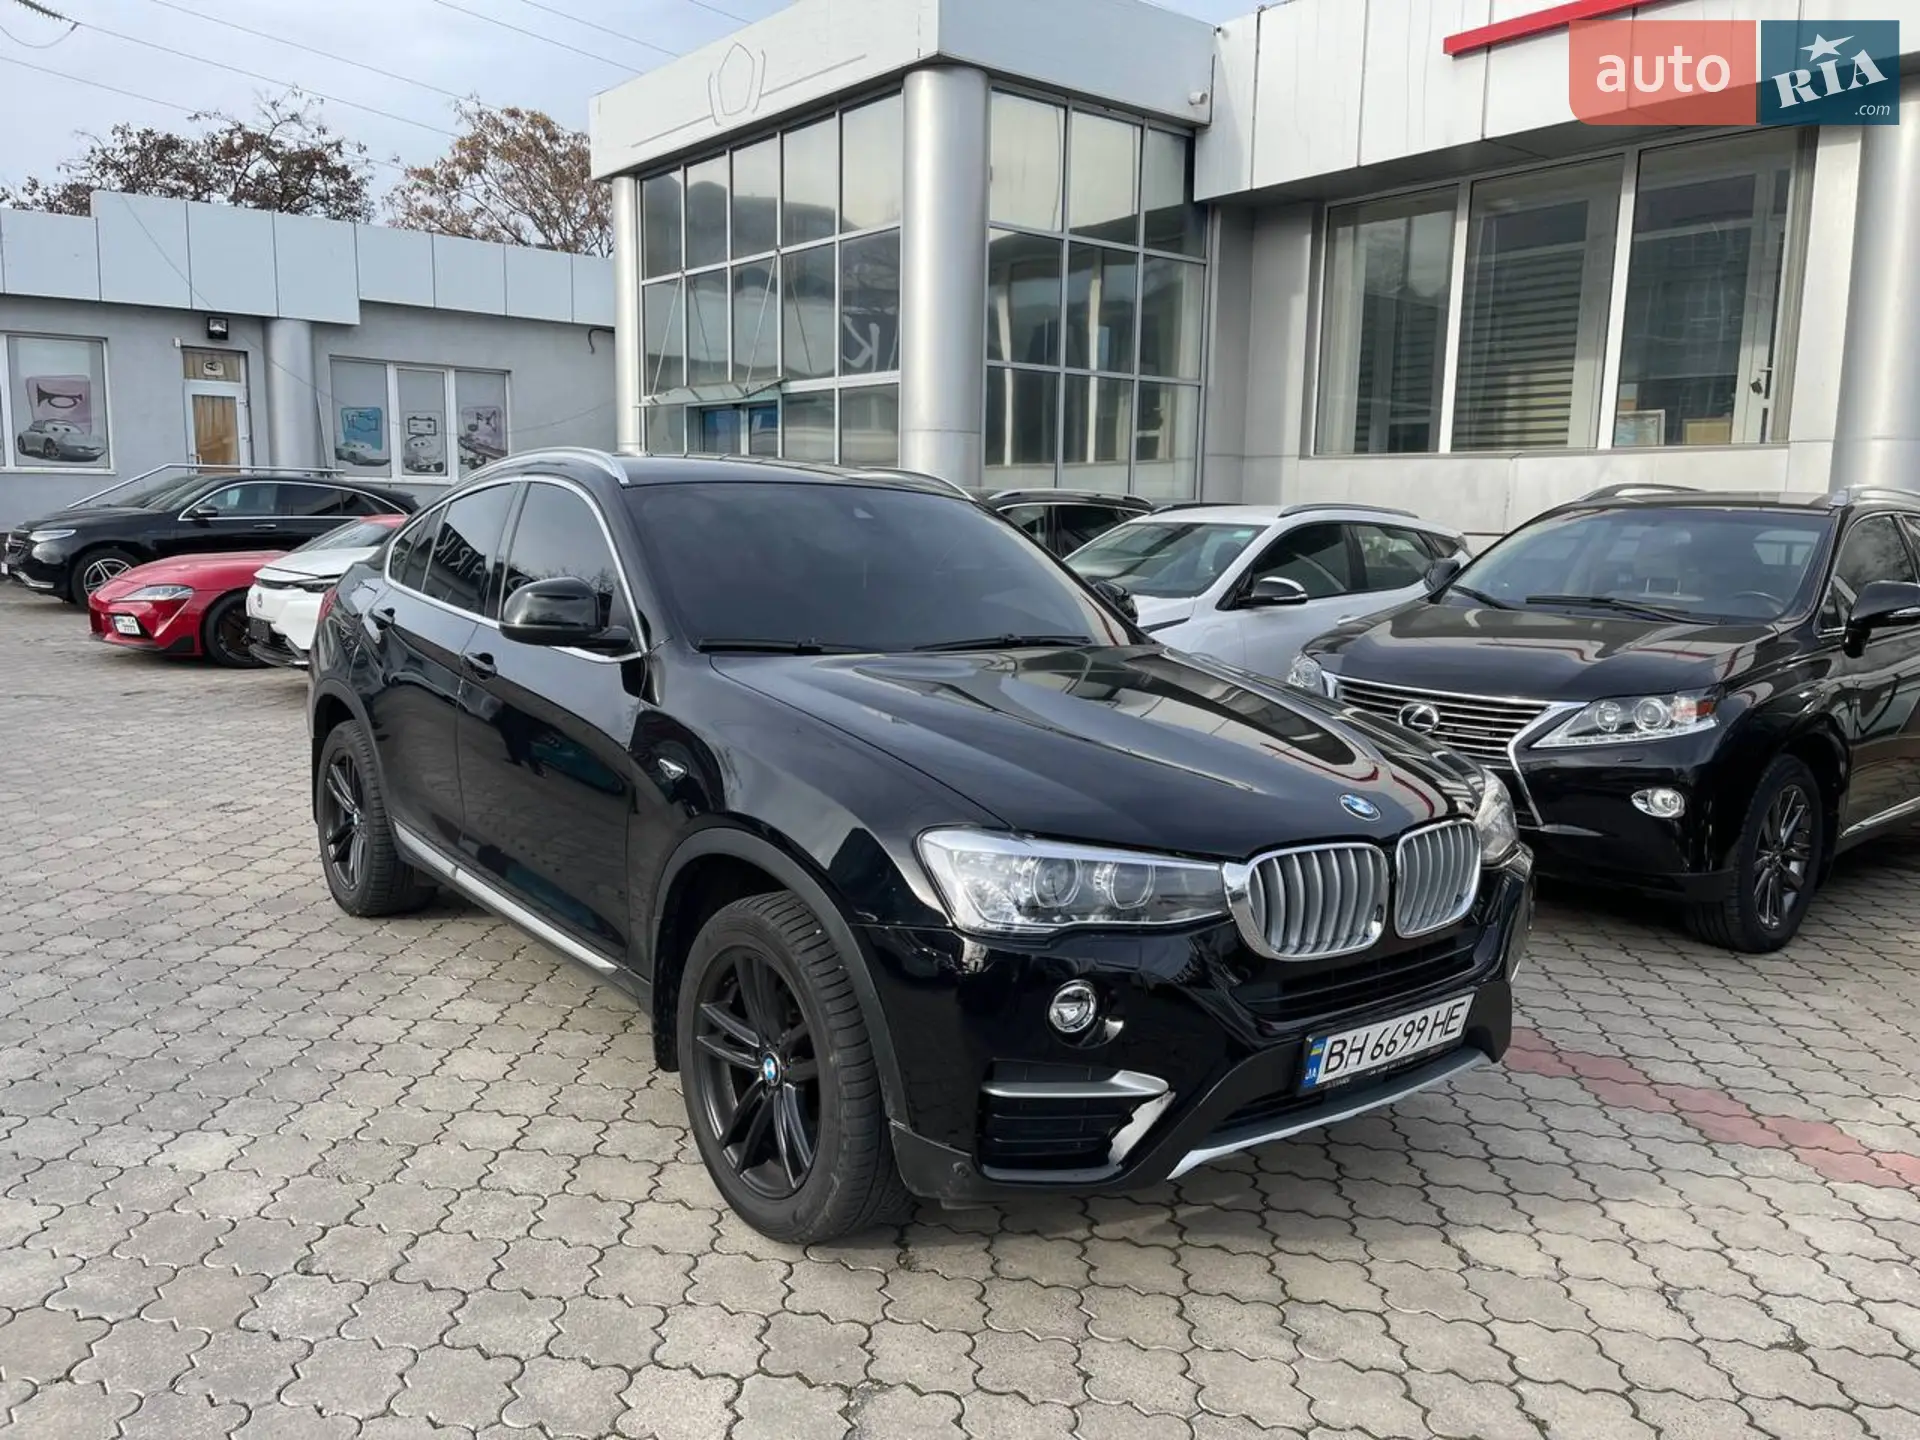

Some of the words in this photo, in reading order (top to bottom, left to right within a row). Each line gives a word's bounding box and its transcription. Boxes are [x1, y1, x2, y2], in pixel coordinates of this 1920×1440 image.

[1324, 1033, 1369, 1074] BH
[1371, 1016, 1429, 1060] 6699
[1428, 1002, 1466, 1040] HE
